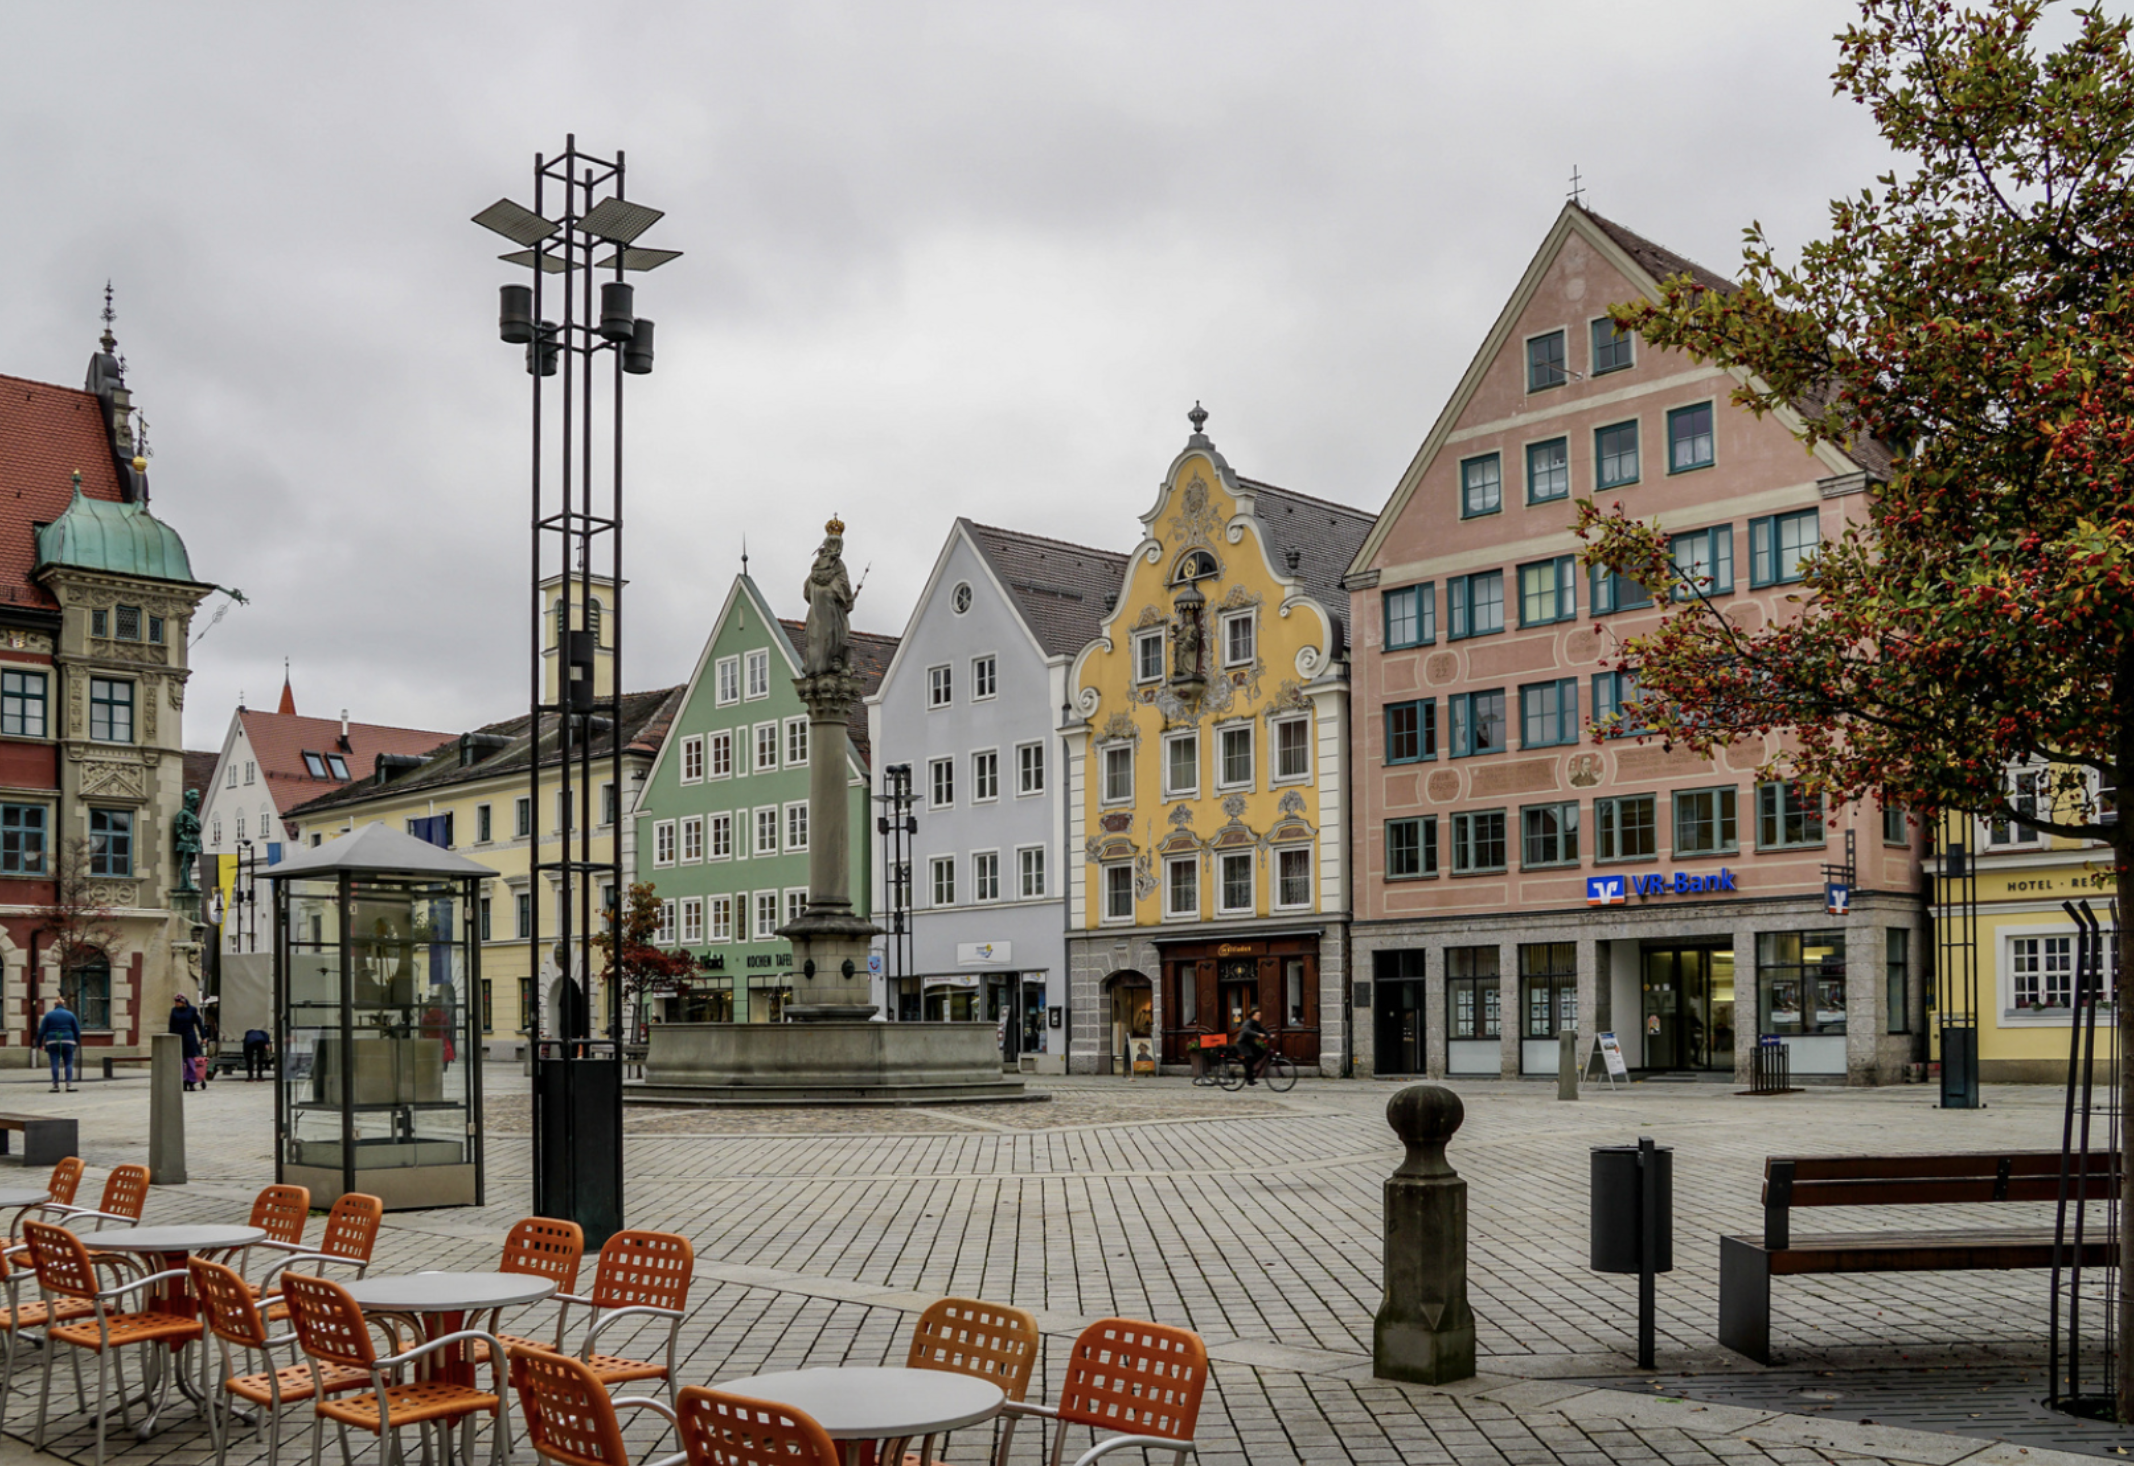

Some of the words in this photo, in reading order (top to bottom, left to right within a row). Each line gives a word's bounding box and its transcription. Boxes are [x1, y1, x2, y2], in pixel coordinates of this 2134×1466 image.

[1631, 867, 1737, 896] VR-Bank
[2007, 879, 2053, 892] HOTEL
[746, 954, 772, 968] KOCHEN
